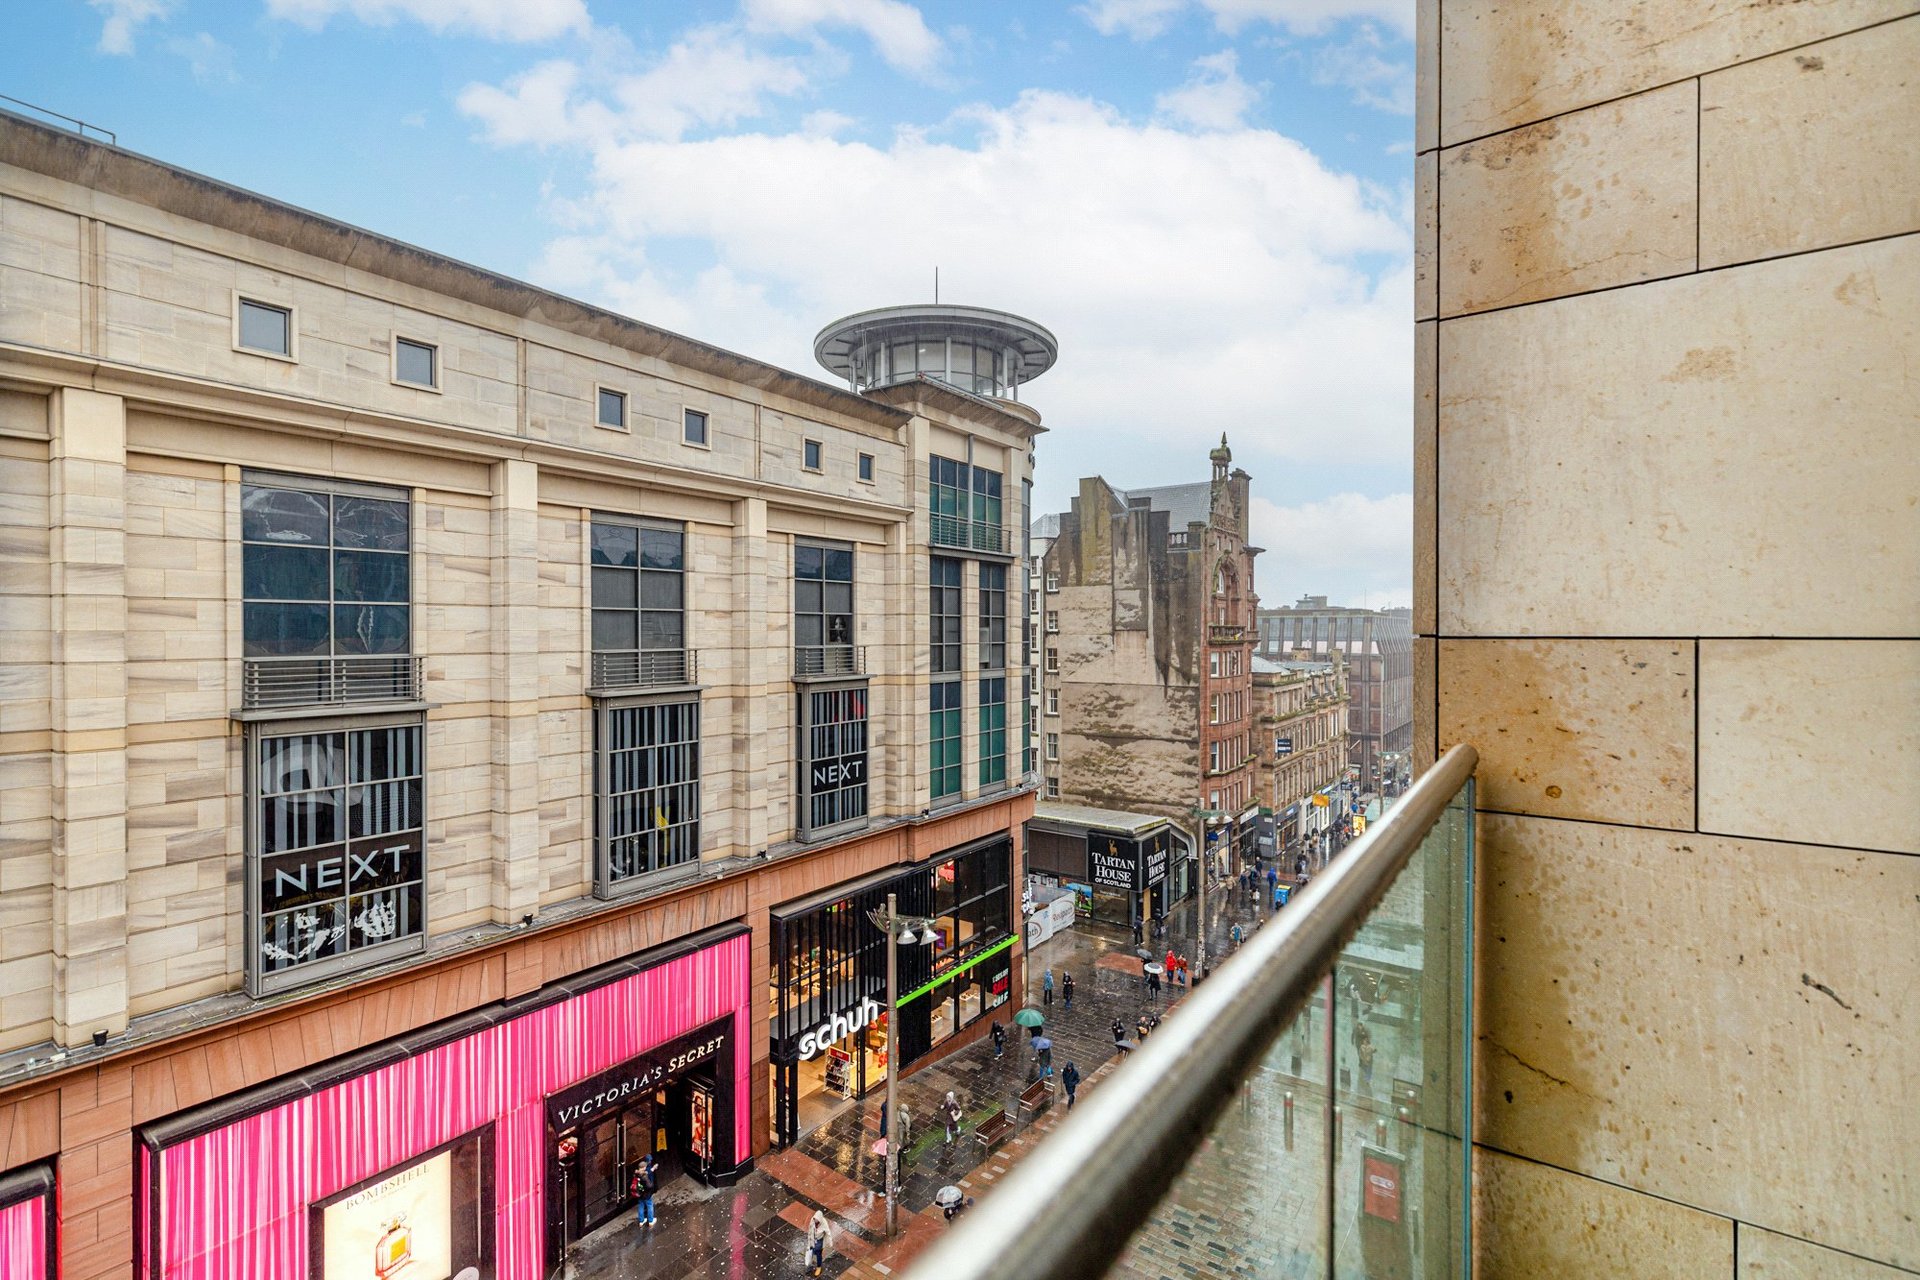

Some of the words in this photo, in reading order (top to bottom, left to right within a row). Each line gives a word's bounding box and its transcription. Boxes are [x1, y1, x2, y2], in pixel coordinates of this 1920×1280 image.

[813, 760, 863, 786] NEXT
[1091, 852, 1136, 870] TARTAN
[1146, 849, 1167, 868] TARTAN
[275, 844, 410, 898] NEXT
[1095, 865, 1132, 882] HOUSE
[1148, 862, 1166, 879] HOUSE
[1103, 878, 1132, 889] SCOTLAND
[799, 996, 879, 1061] schuh
[558, 1066, 662, 1124] VICTORIA'S
[667, 1035, 724, 1073] SECRET
[346, 1164, 430, 1210] BOMBSHELL
